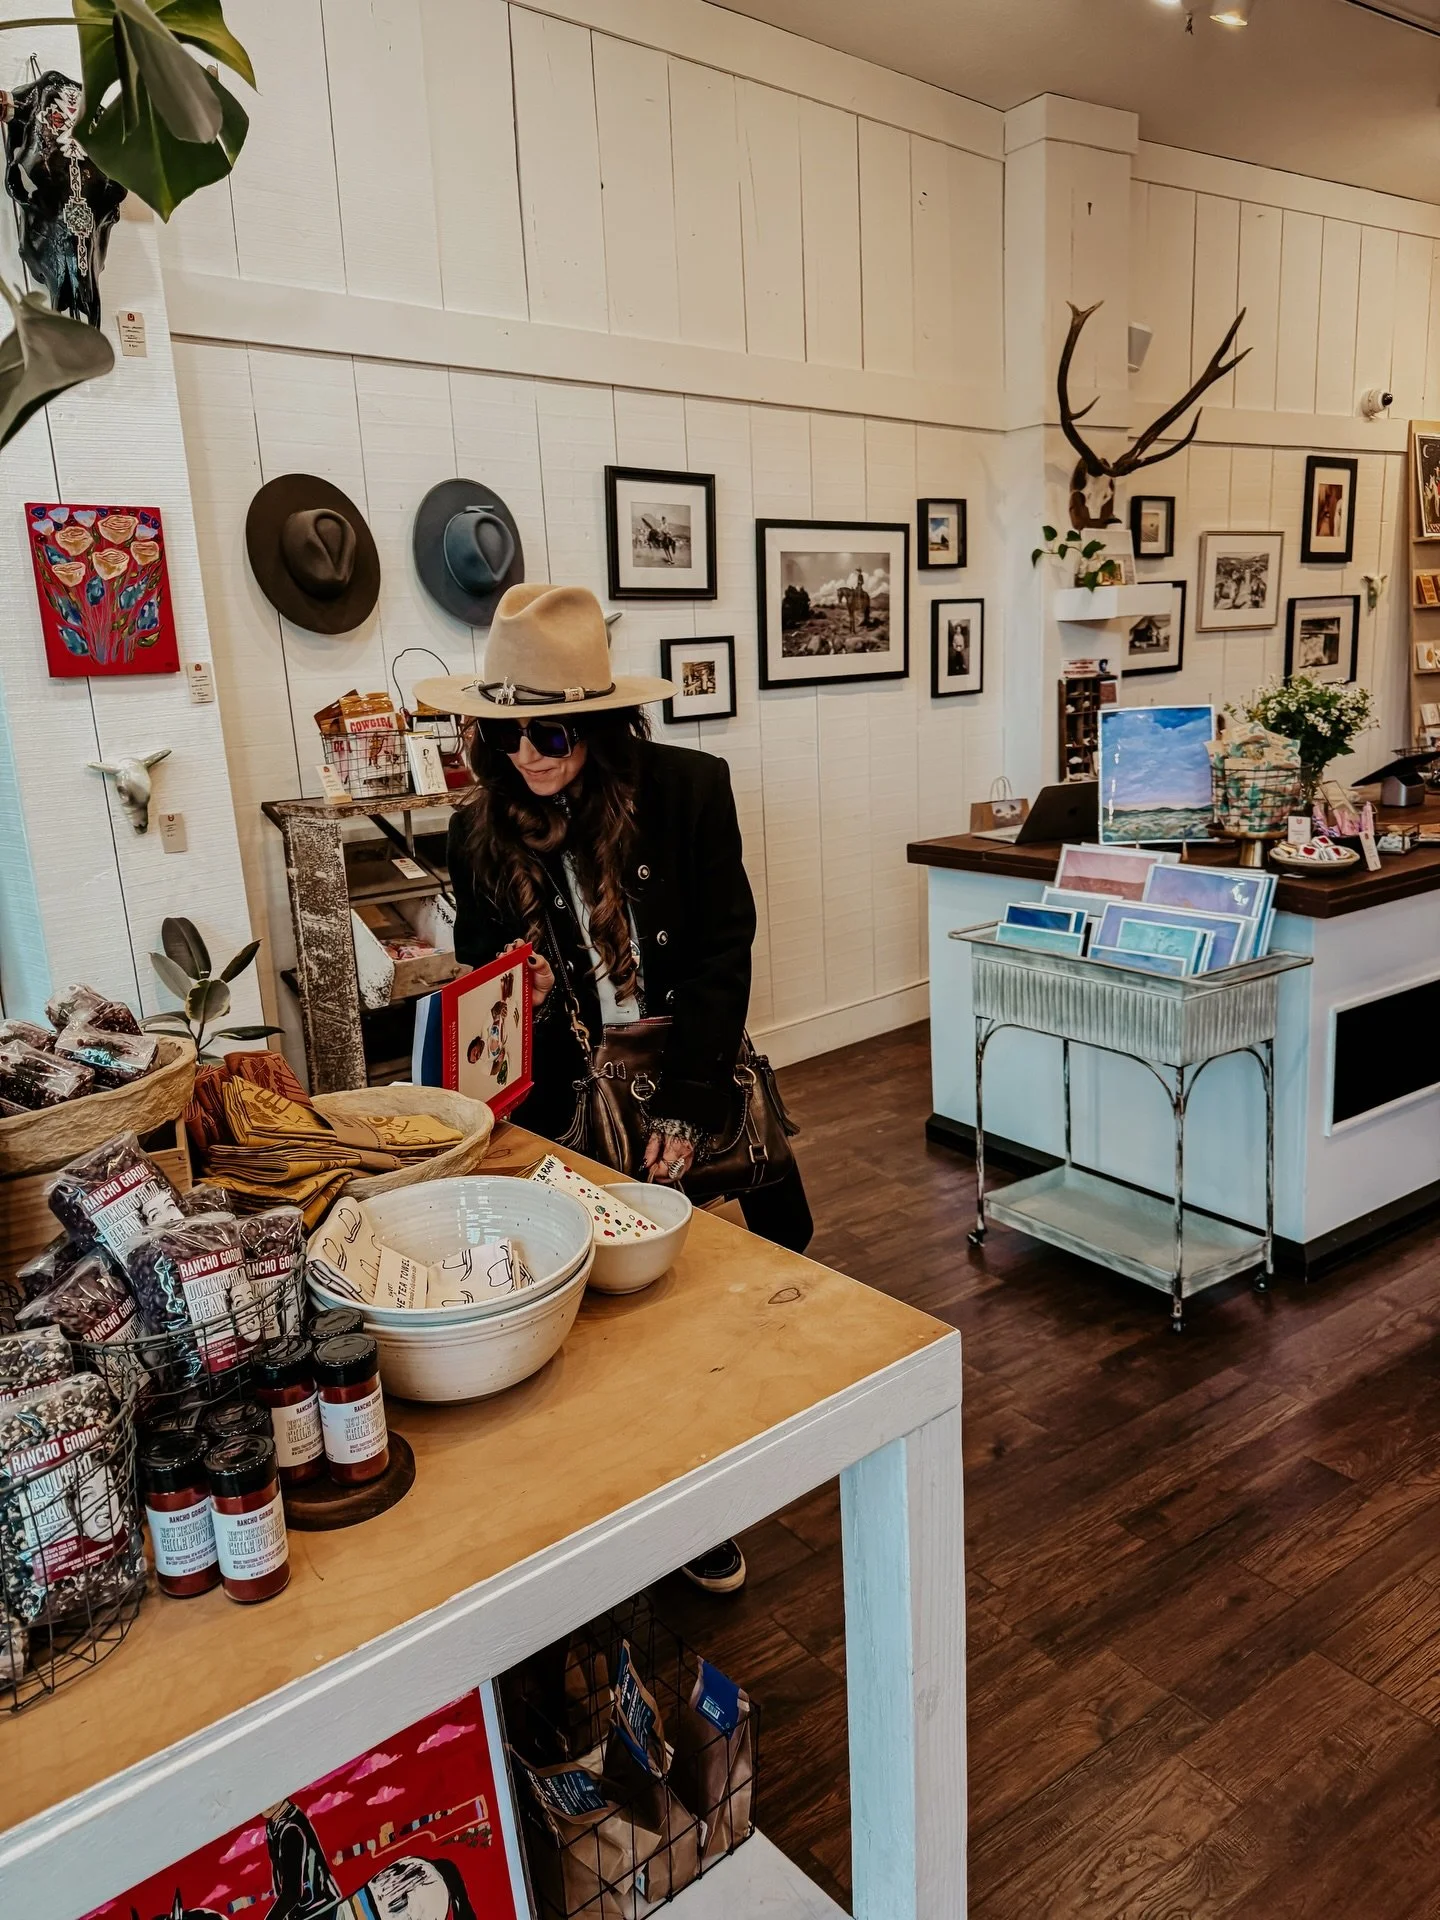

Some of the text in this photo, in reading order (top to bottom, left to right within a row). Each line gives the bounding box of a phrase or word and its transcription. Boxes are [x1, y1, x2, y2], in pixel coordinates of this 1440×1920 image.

[350, 717, 393, 732] COWGIRL
[540, 1158, 556, 1175] RAW
[82, 1163, 149, 1212] RANCHO GORDO
[94, 1191, 141, 1230] DOMINGO
[105, 1211, 144, 1248] BEAN
[180, 1254, 219, 1278] RANCHO
[246, 1258, 277, 1279] ANCHO
[400, 1257, 410, 1281] TOWEL
[186, 1275, 231, 1301] DOMINGO
[397, 1281, 407, 1297] TEA
[191, 1294, 229, 1322] BEAN
[83, 1312, 121, 1343] RANCHO
[296, 1401, 312, 1414] RANCHO
[354, 1400, 371, 1413] RANCHO
[344, 1425, 371, 1442] CHILE
[11, 1426, 100, 1472] RANCHO GORDO
[169, 1505, 207, 1524] RANCHO GORDO
[236, 1507, 274, 1527] RANCHO GORDO
[161, 1537, 188, 1552] CHILE
[228, 1540, 256, 1556] CHILE
